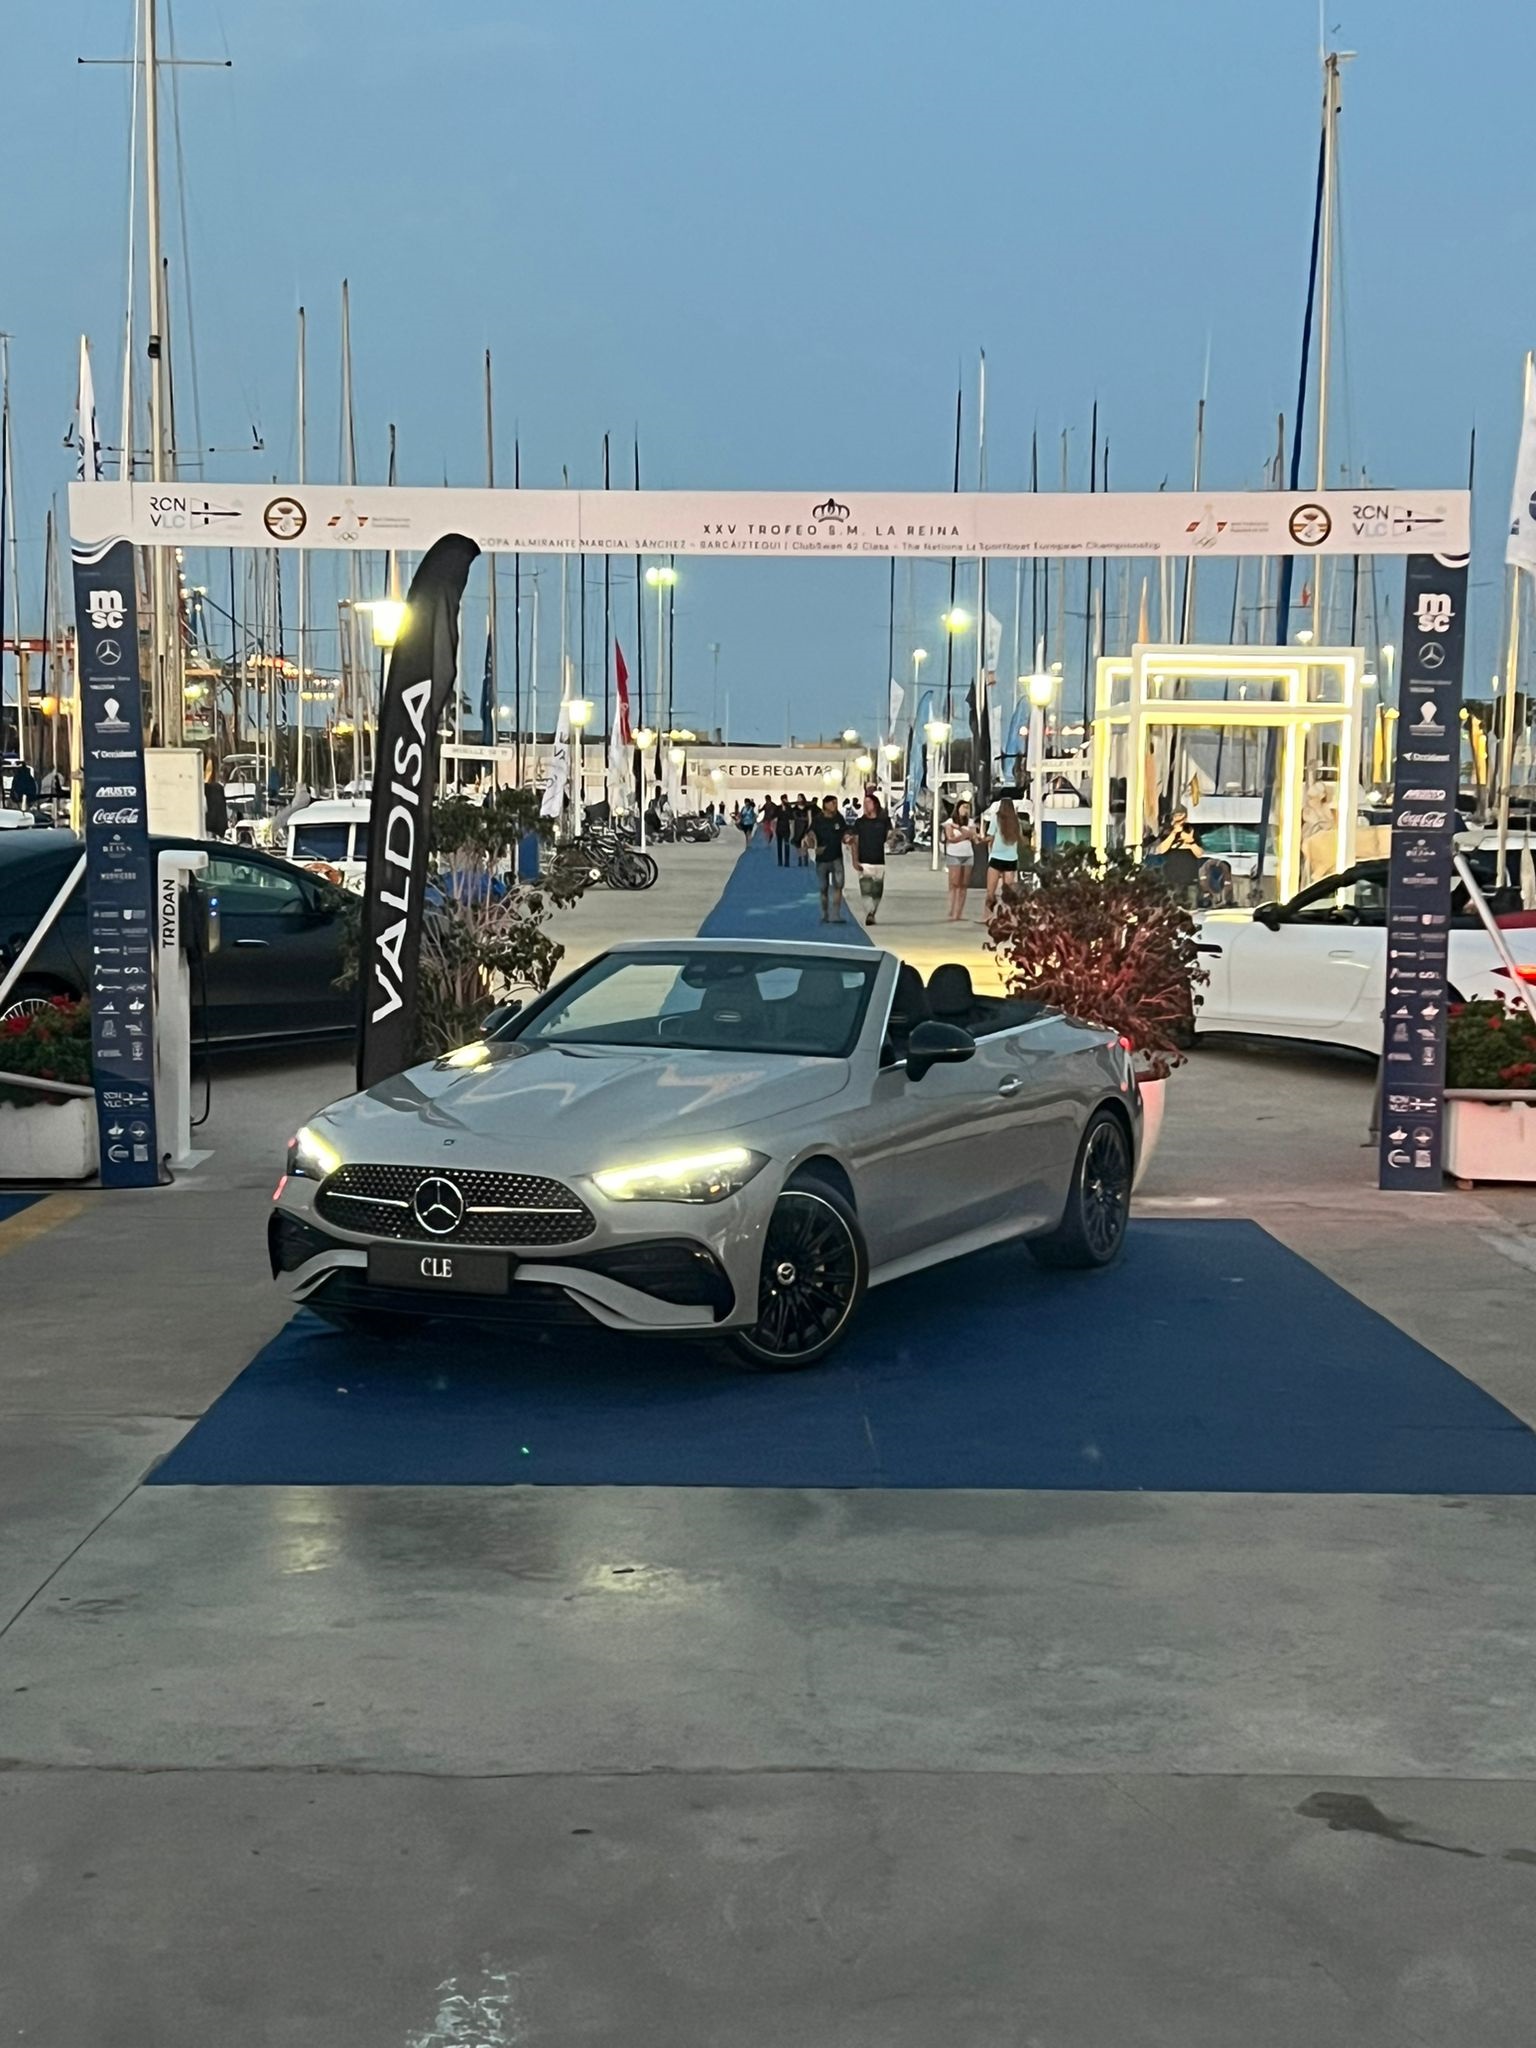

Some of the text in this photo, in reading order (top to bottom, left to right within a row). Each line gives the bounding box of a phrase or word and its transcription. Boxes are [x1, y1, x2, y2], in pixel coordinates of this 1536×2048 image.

[149, 496, 186, 511] RCN
[1352, 504, 1389, 520] RCN
[149, 513, 189, 528] VLC
[703, 524, 737, 535] XXV
[748, 524, 817, 536] TROFEO
[875, 525, 896, 536] LA
[907, 525, 960, 536] REINA
[1352, 522, 1389, 537] VLC
[479, 537, 510, 547] COPA
[514, 538, 576, 548] ALMIRANTE
[579, 538, 629, 548] MARCIAL
[635, 537, 686, 549] SÁNCHEZ
[902, 541, 920, 550] The
[741, 765, 760, 776] DE
[371, 679, 432, 1023] VALDISA
[162, 879, 176, 949] TRYDAN
[420, 1256, 453, 1278] CLE
